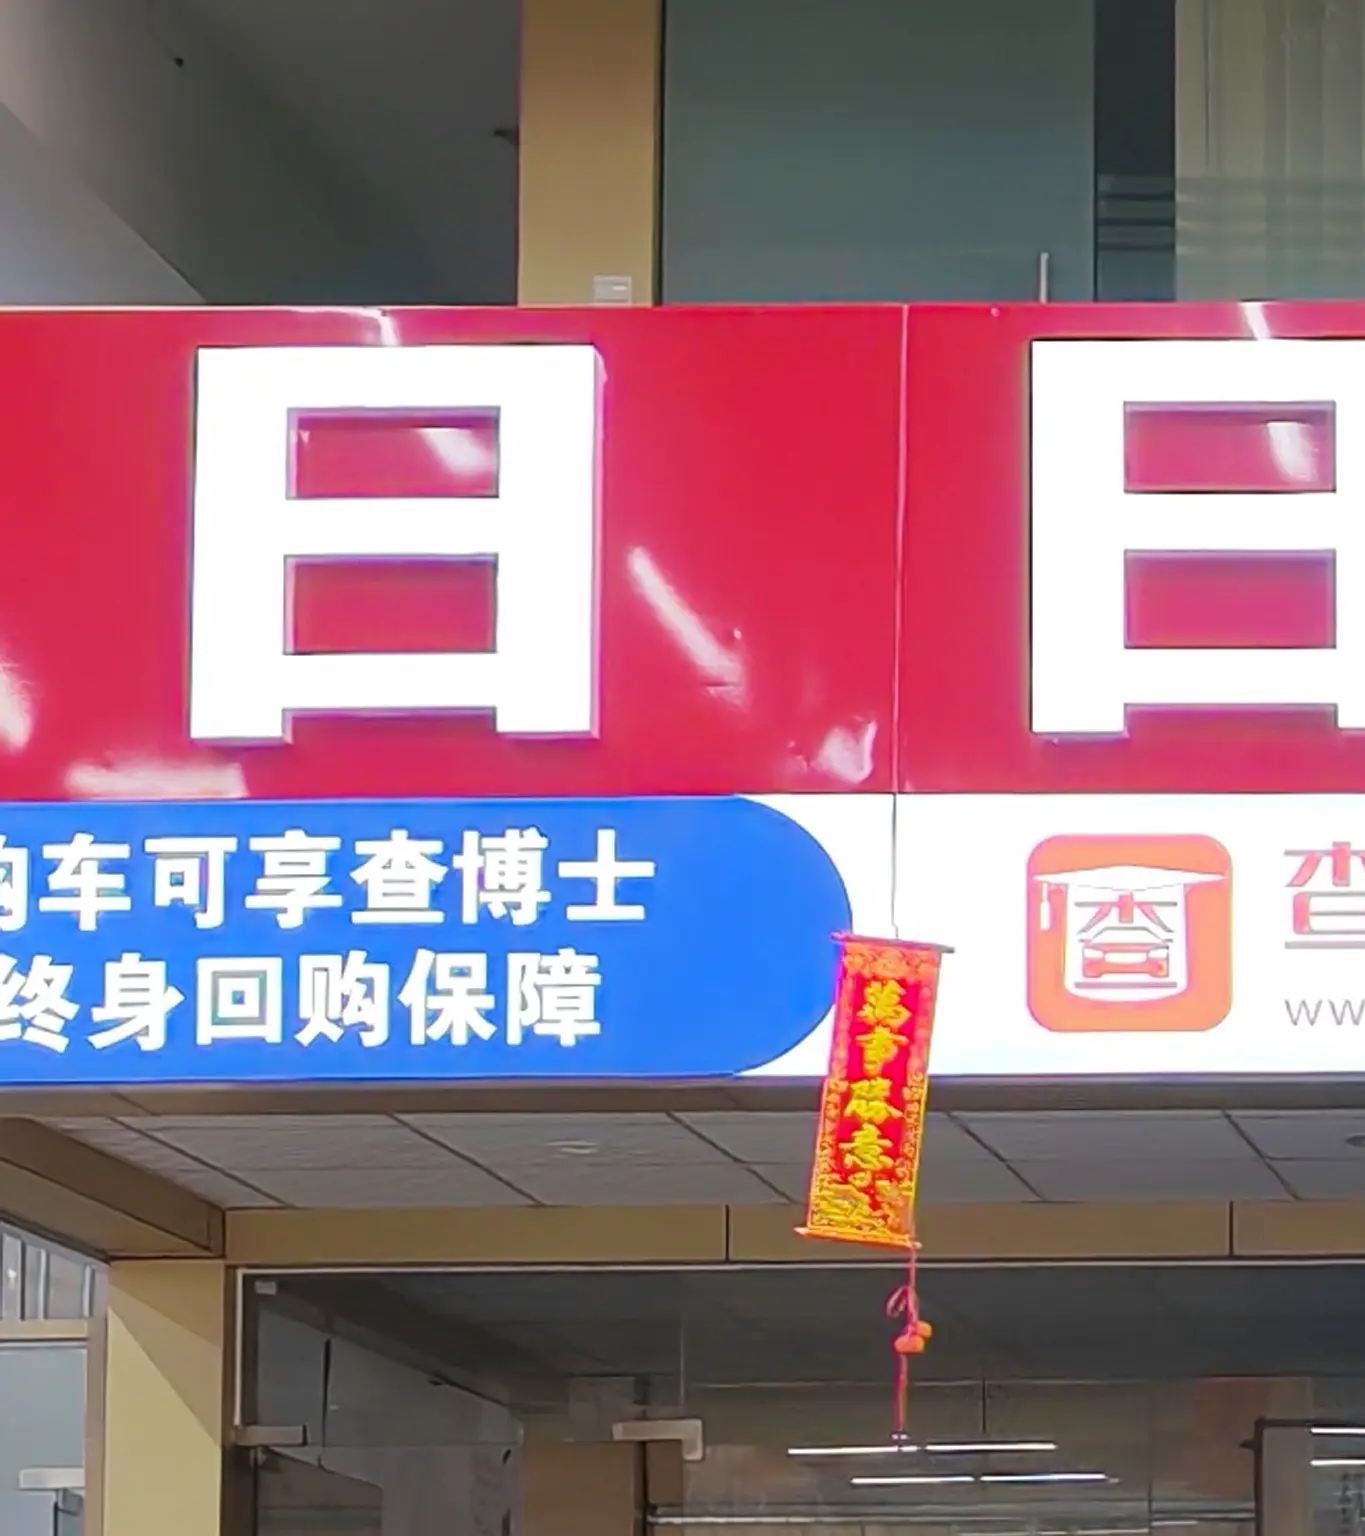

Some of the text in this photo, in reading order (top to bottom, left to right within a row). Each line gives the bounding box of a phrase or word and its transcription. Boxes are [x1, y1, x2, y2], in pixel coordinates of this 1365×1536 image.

[0, 950, 603, 1054] 终身回购保障
